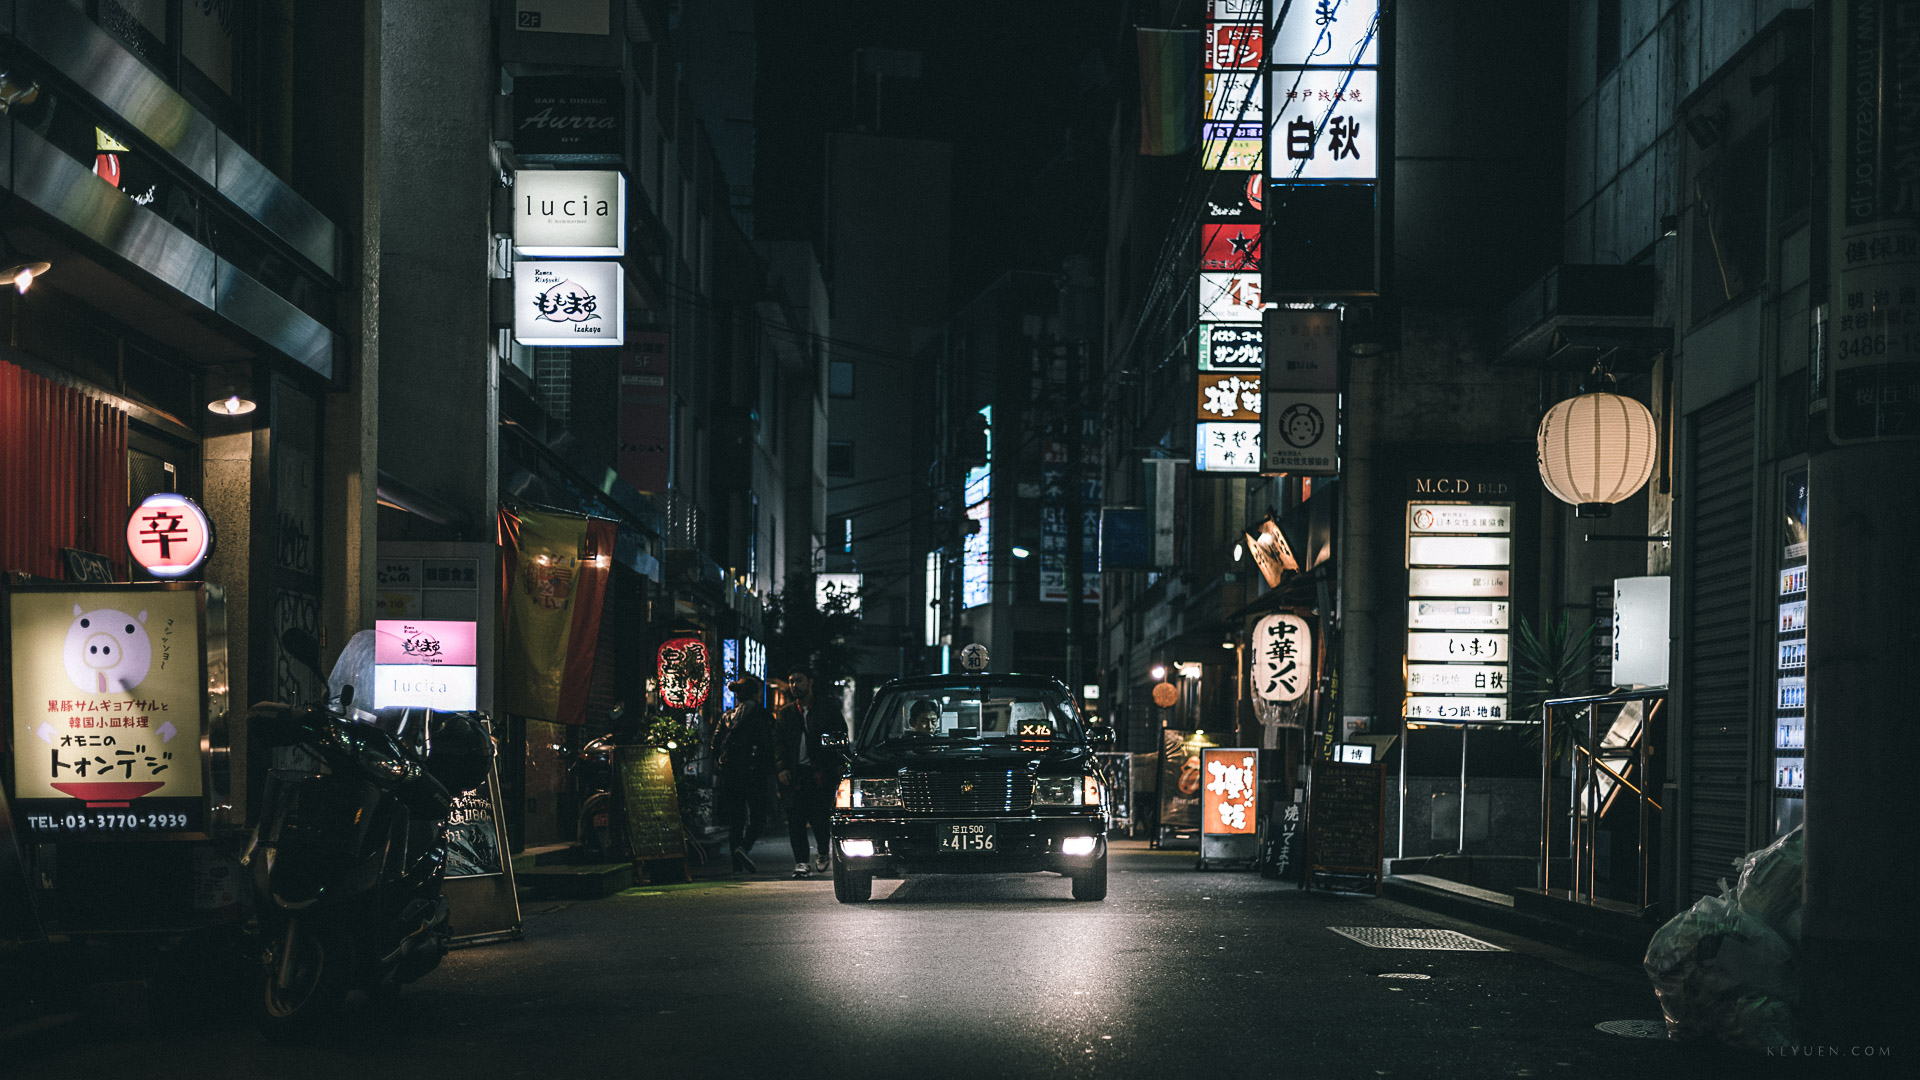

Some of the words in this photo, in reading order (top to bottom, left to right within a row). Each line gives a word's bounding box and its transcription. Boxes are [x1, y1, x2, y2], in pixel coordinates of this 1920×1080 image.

[520, 13, 539, 27] 2F
[519, 106, 617, 130] Aurra
[1287, 115, 1361, 161] 白秋
[526, 195, 608, 217] lucia
[533, 291, 597, 315] ももまる
[574, 324, 602, 334] Izakaya
[1416, 479, 1469, 493] M.C.D
[1478, 483, 1508, 494] BLD
[139, 511, 188, 559] 辛
[70, 551, 114, 583] OPEN
[968, 646, 981, 668] 大和
[1265, 621, 1298, 694] 中華ソバ
[1448, 638, 1498, 658] いまり
[1475, 672, 1504, 689] 白秋
[69, 716, 149, 728] 韓国小皿料理
[61, 735, 116, 747] オモニの
[28, 814, 188, 829] TEL:03-3770-2939
[951, 835, 993, 850] 41-56
[1276, 803, 1299, 876] 焼いてます
